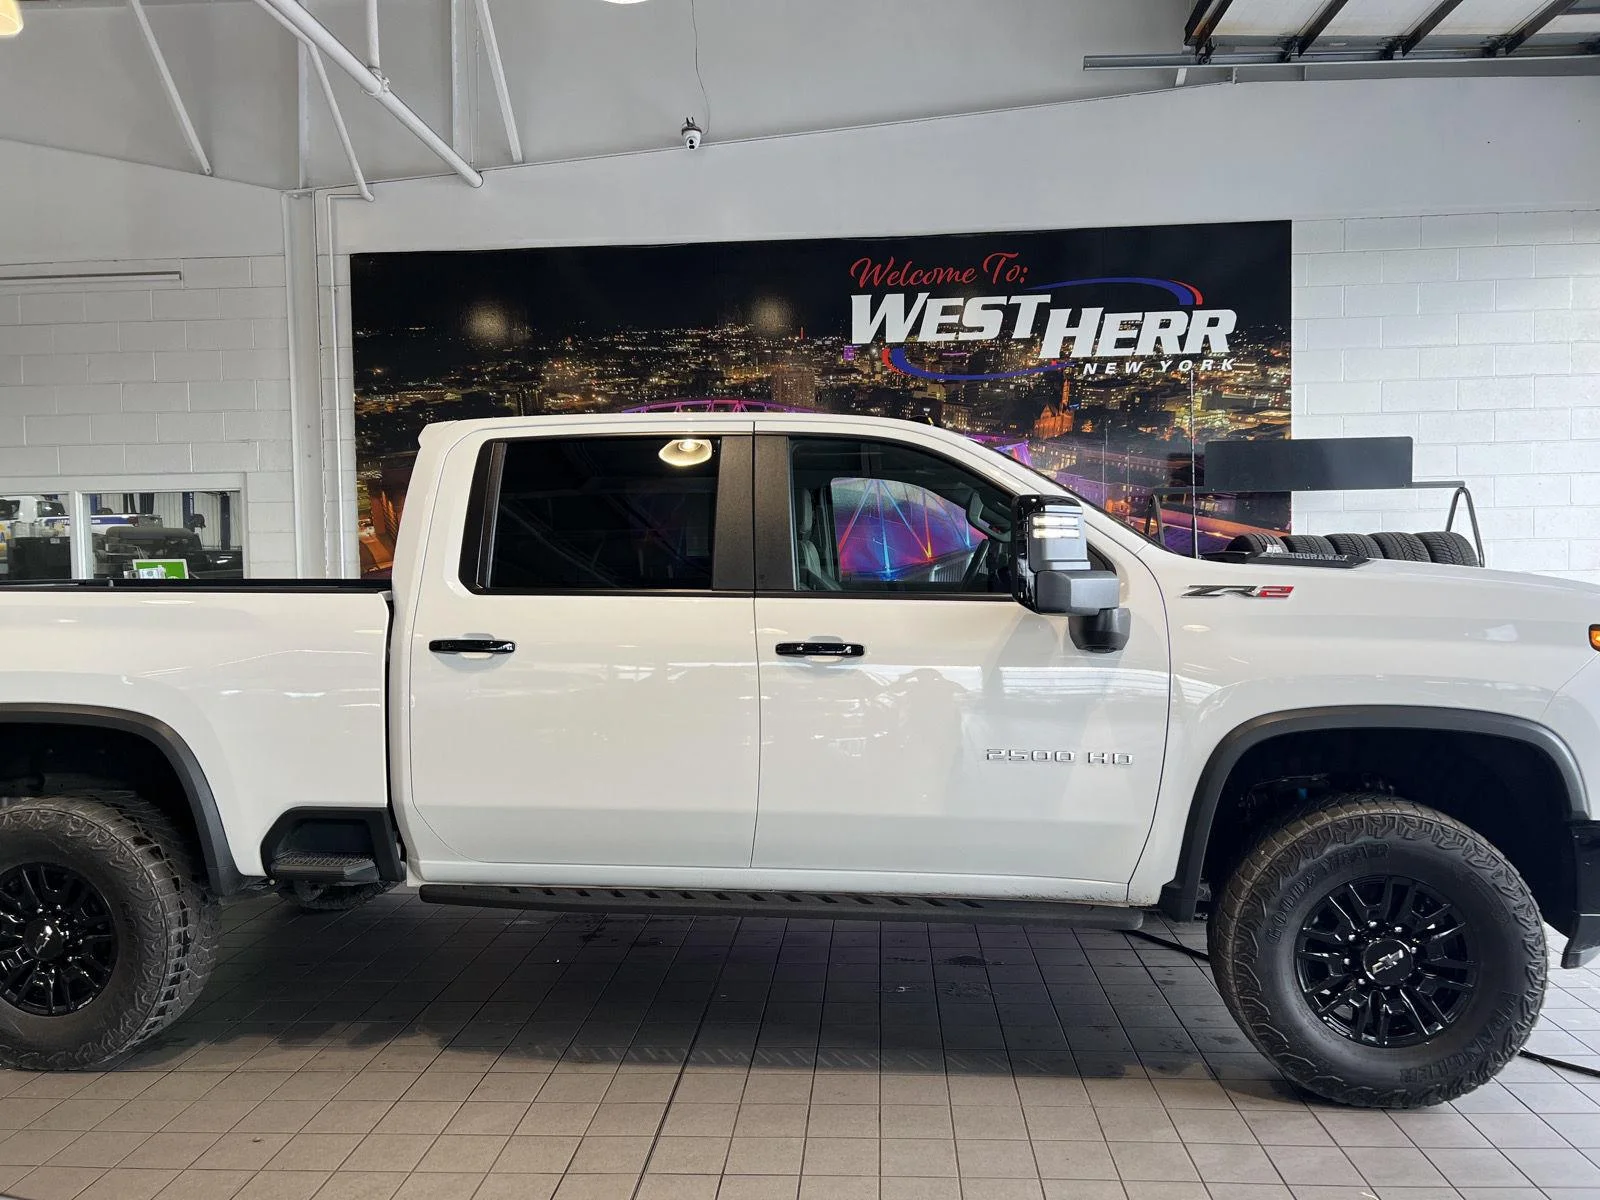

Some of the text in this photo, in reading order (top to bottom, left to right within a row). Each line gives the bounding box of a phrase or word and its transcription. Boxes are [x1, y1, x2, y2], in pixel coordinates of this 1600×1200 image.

[850, 252, 1029, 288] Welcome To:
[850, 292, 1238, 360] WEST HERR
[1082, 357, 1236, 376] NEW YORK
[1182, 584, 1295, 599] ZR2
[986, 748, 1134, 766] 2500 HD
